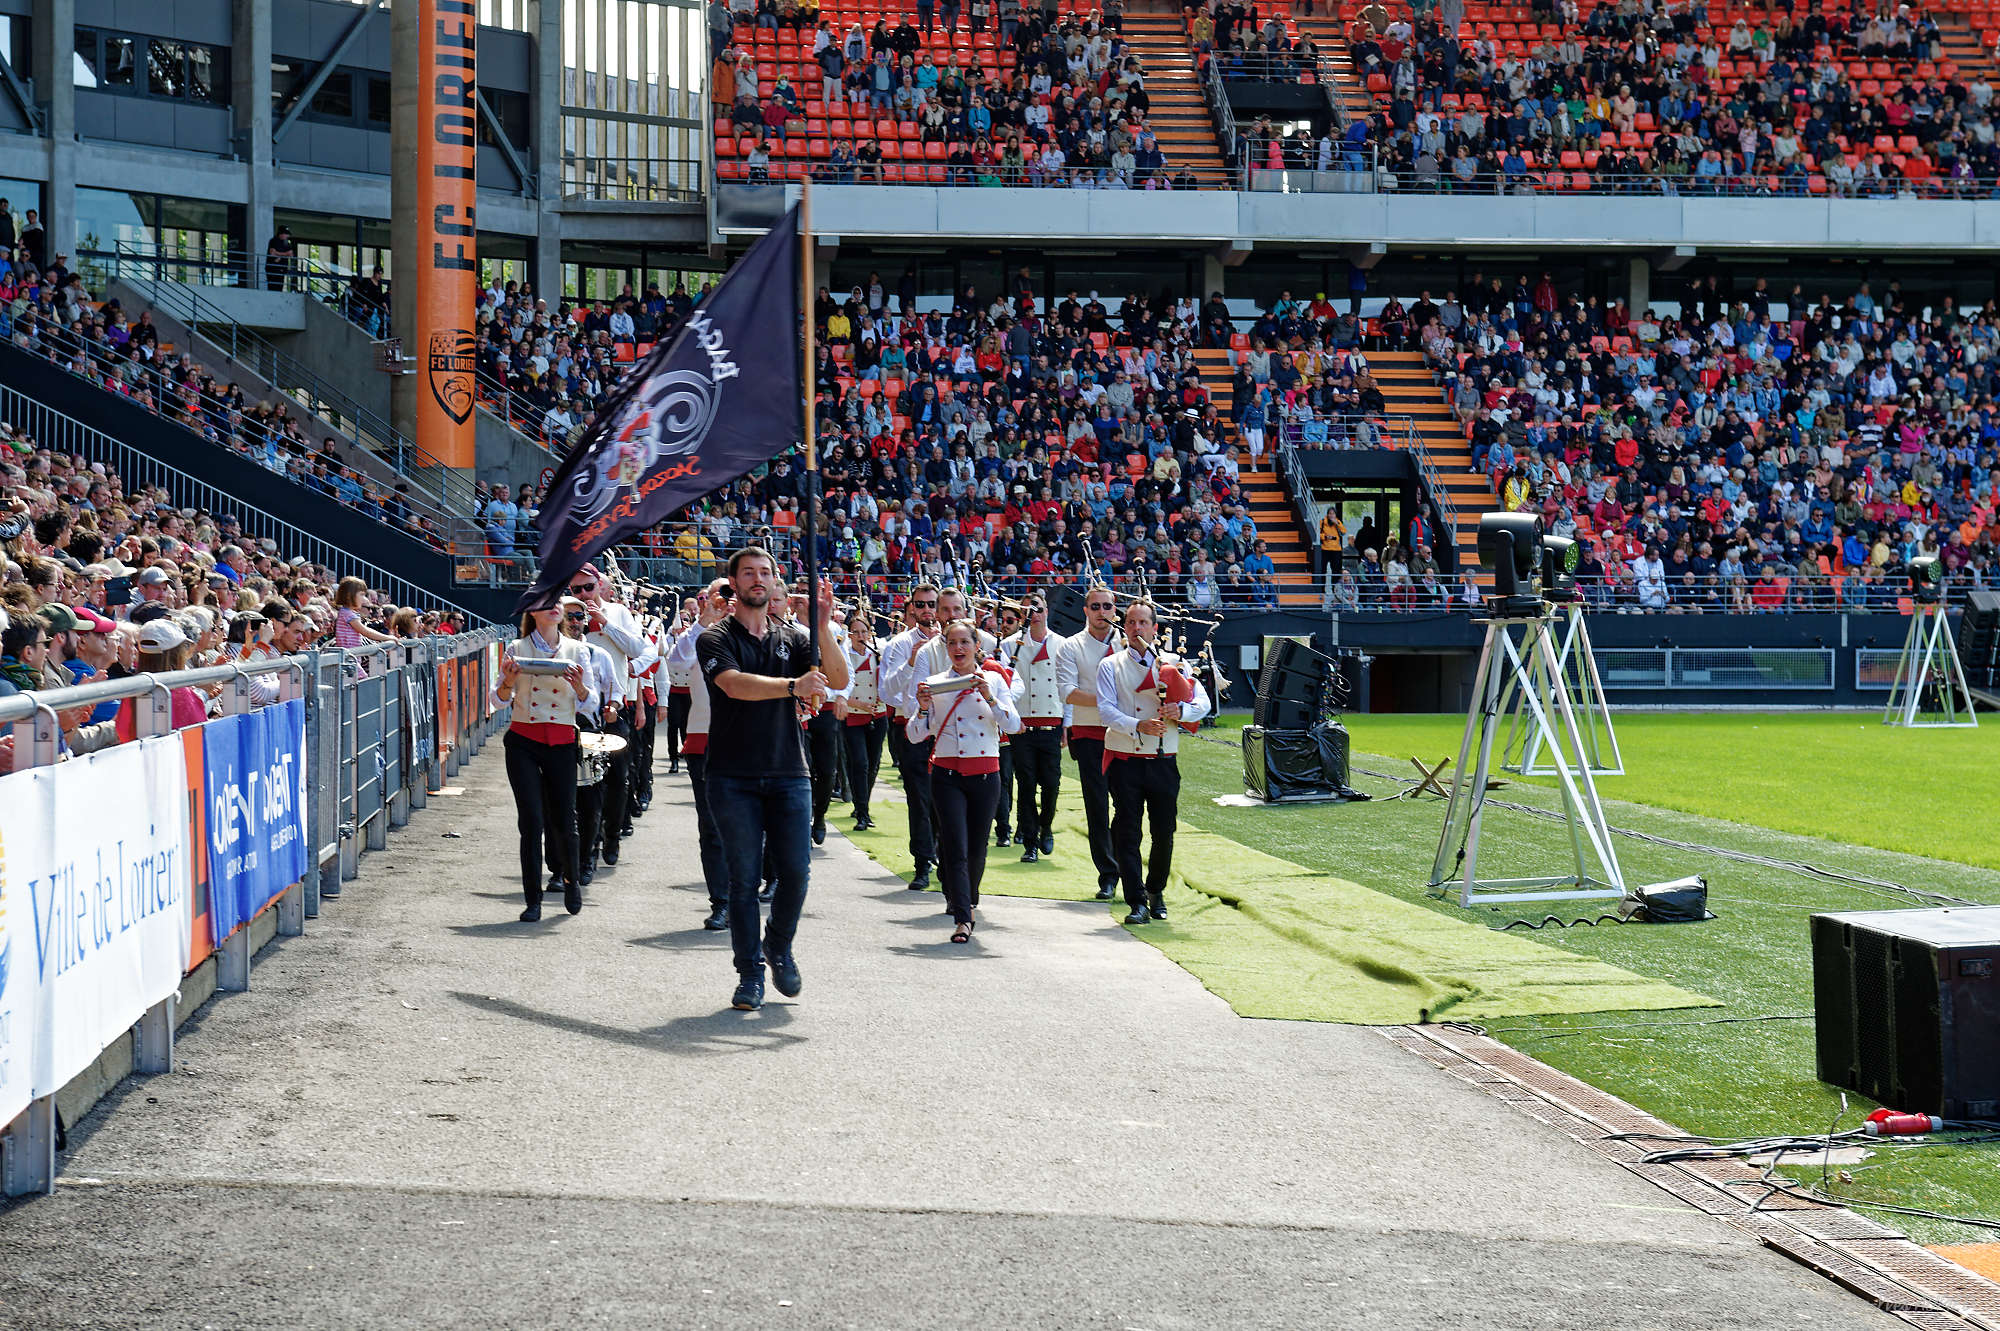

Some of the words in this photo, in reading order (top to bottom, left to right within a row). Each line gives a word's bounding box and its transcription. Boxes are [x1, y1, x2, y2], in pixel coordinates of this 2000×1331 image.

[434, 203, 475, 272] FC
[431, 356, 445, 369] FC
[448, 357, 475, 371] LORIE
[28, 860, 86, 987] Ville
[93, 846, 113, 951] de
